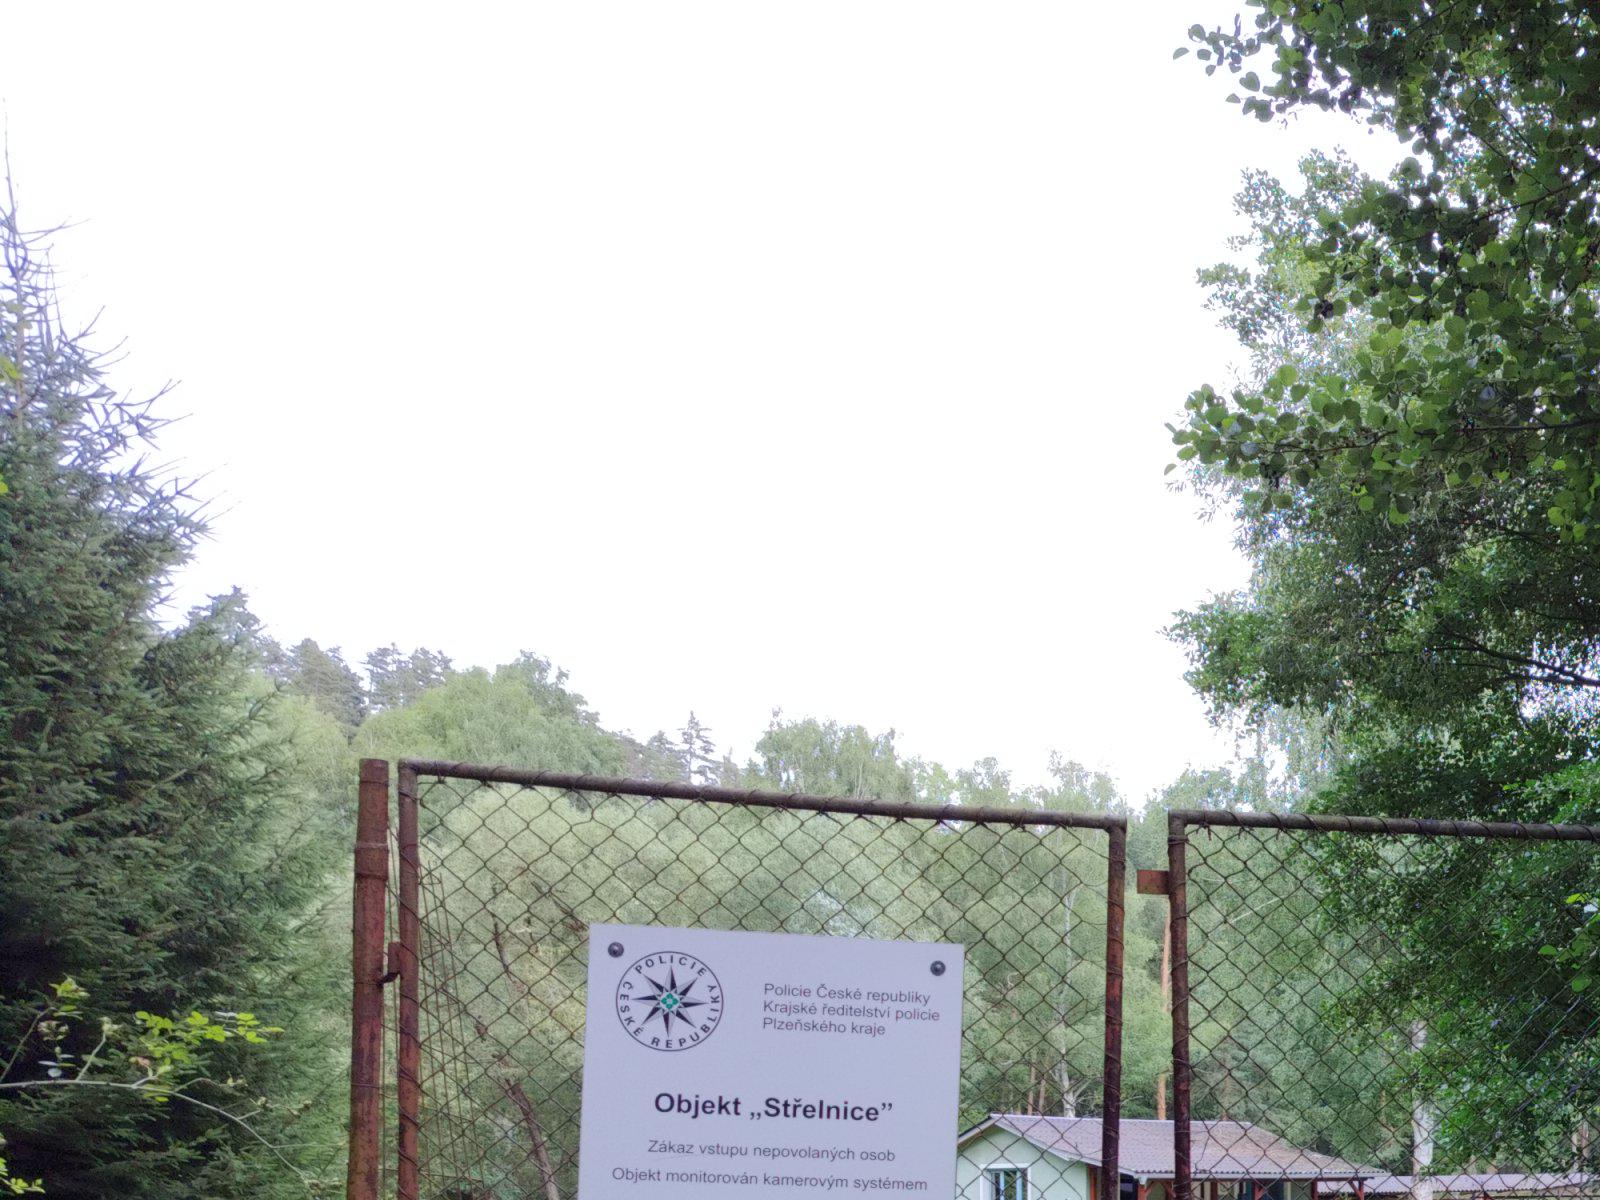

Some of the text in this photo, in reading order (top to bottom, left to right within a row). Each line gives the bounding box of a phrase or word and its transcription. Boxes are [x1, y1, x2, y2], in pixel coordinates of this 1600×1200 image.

[635, 955, 707, 977] POLICIE
[764, 982, 931, 1007] Policie České republiky
[651, 984, 720, 1049] REPUBLIKY
[763, 1000, 941, 1022] Krajské ředitelství policie
[762, 1017, 886, 1037] Plzeňského kraje
[654, 1092, 742, 1120] Objekt
[647, 1140, 896, 1163] Zákaz vstupu nepovolaných osob
[612, 1167, 928, 1192] Objekt monitorován kamerovým systémem
